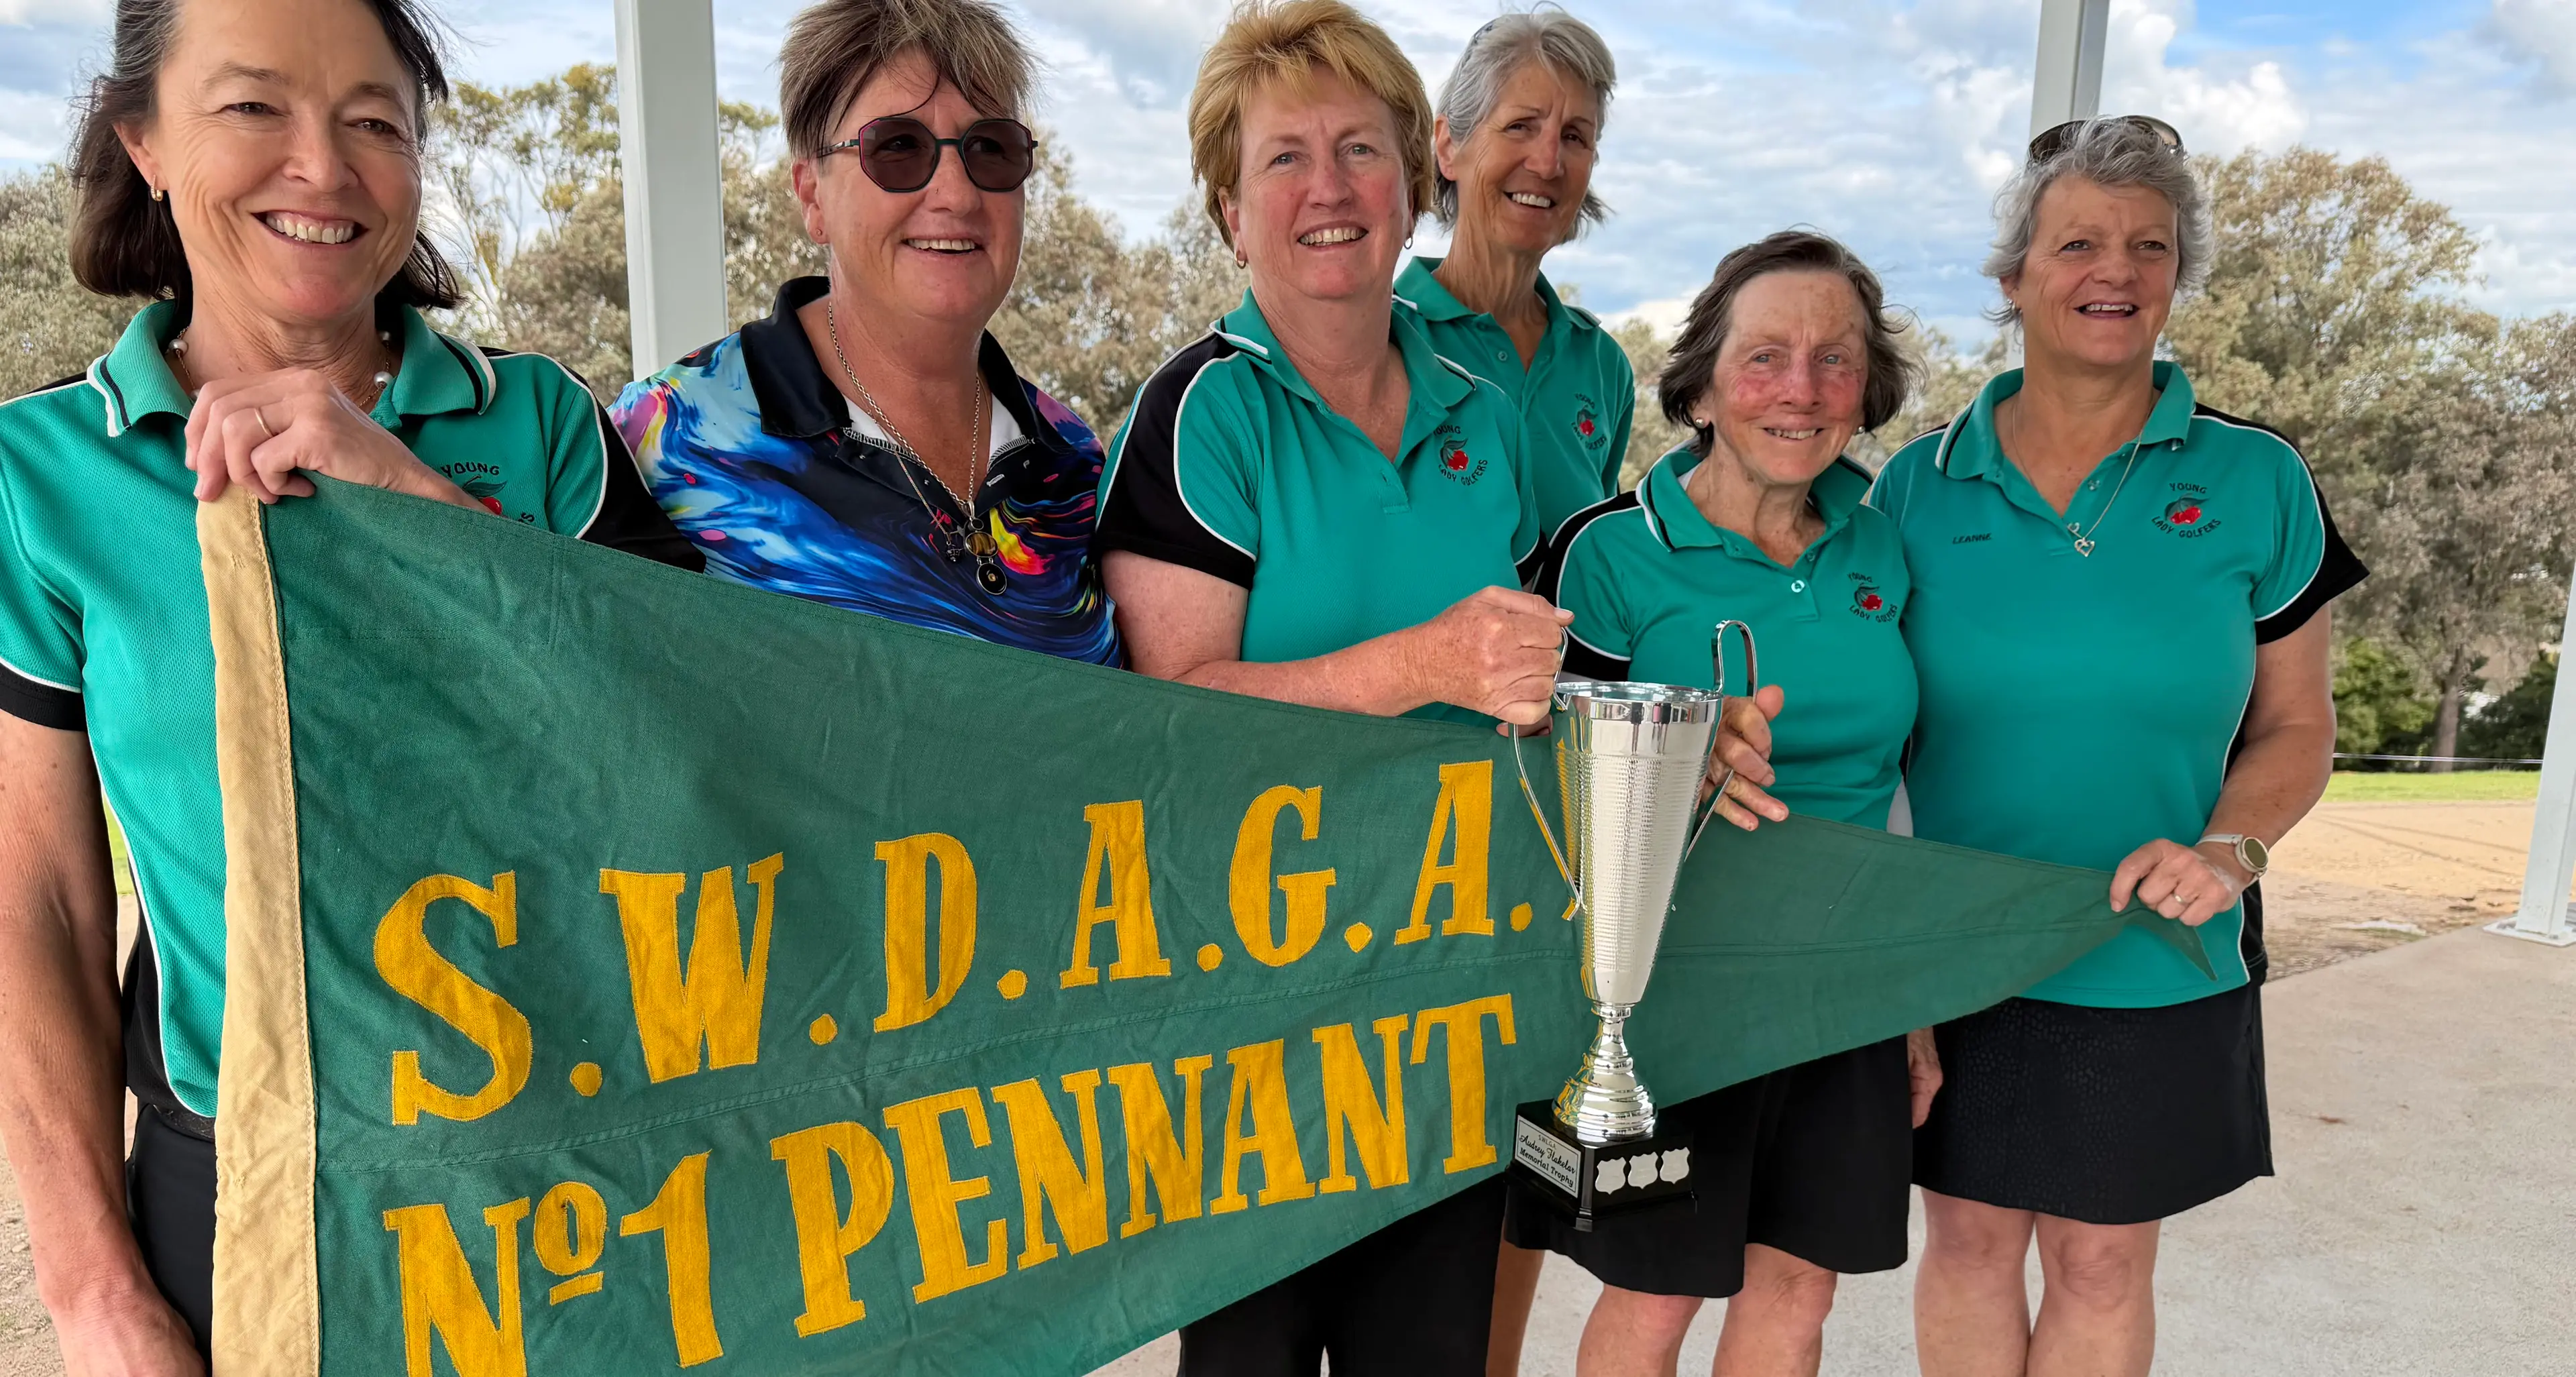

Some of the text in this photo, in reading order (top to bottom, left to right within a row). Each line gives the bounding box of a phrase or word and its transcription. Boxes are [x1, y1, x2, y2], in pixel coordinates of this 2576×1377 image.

[441, 461, 500, 478] YOUNG
[1461, 459, 1488, 486] GOLFERS
[2169, 482, 2207, 494] YOUNG
[2151, 516, 2222, 538] LADY GOLFERS
[1952, 533, 1992, 545] LEANNE
[1849, 605, 1870, 620] LADY
[1519, 1135, 1546, 1158] Audrey
[770, 993, 1516, 1337] PENNANT
[1519, 1148, 1574, 1188] Memorial Trophy
